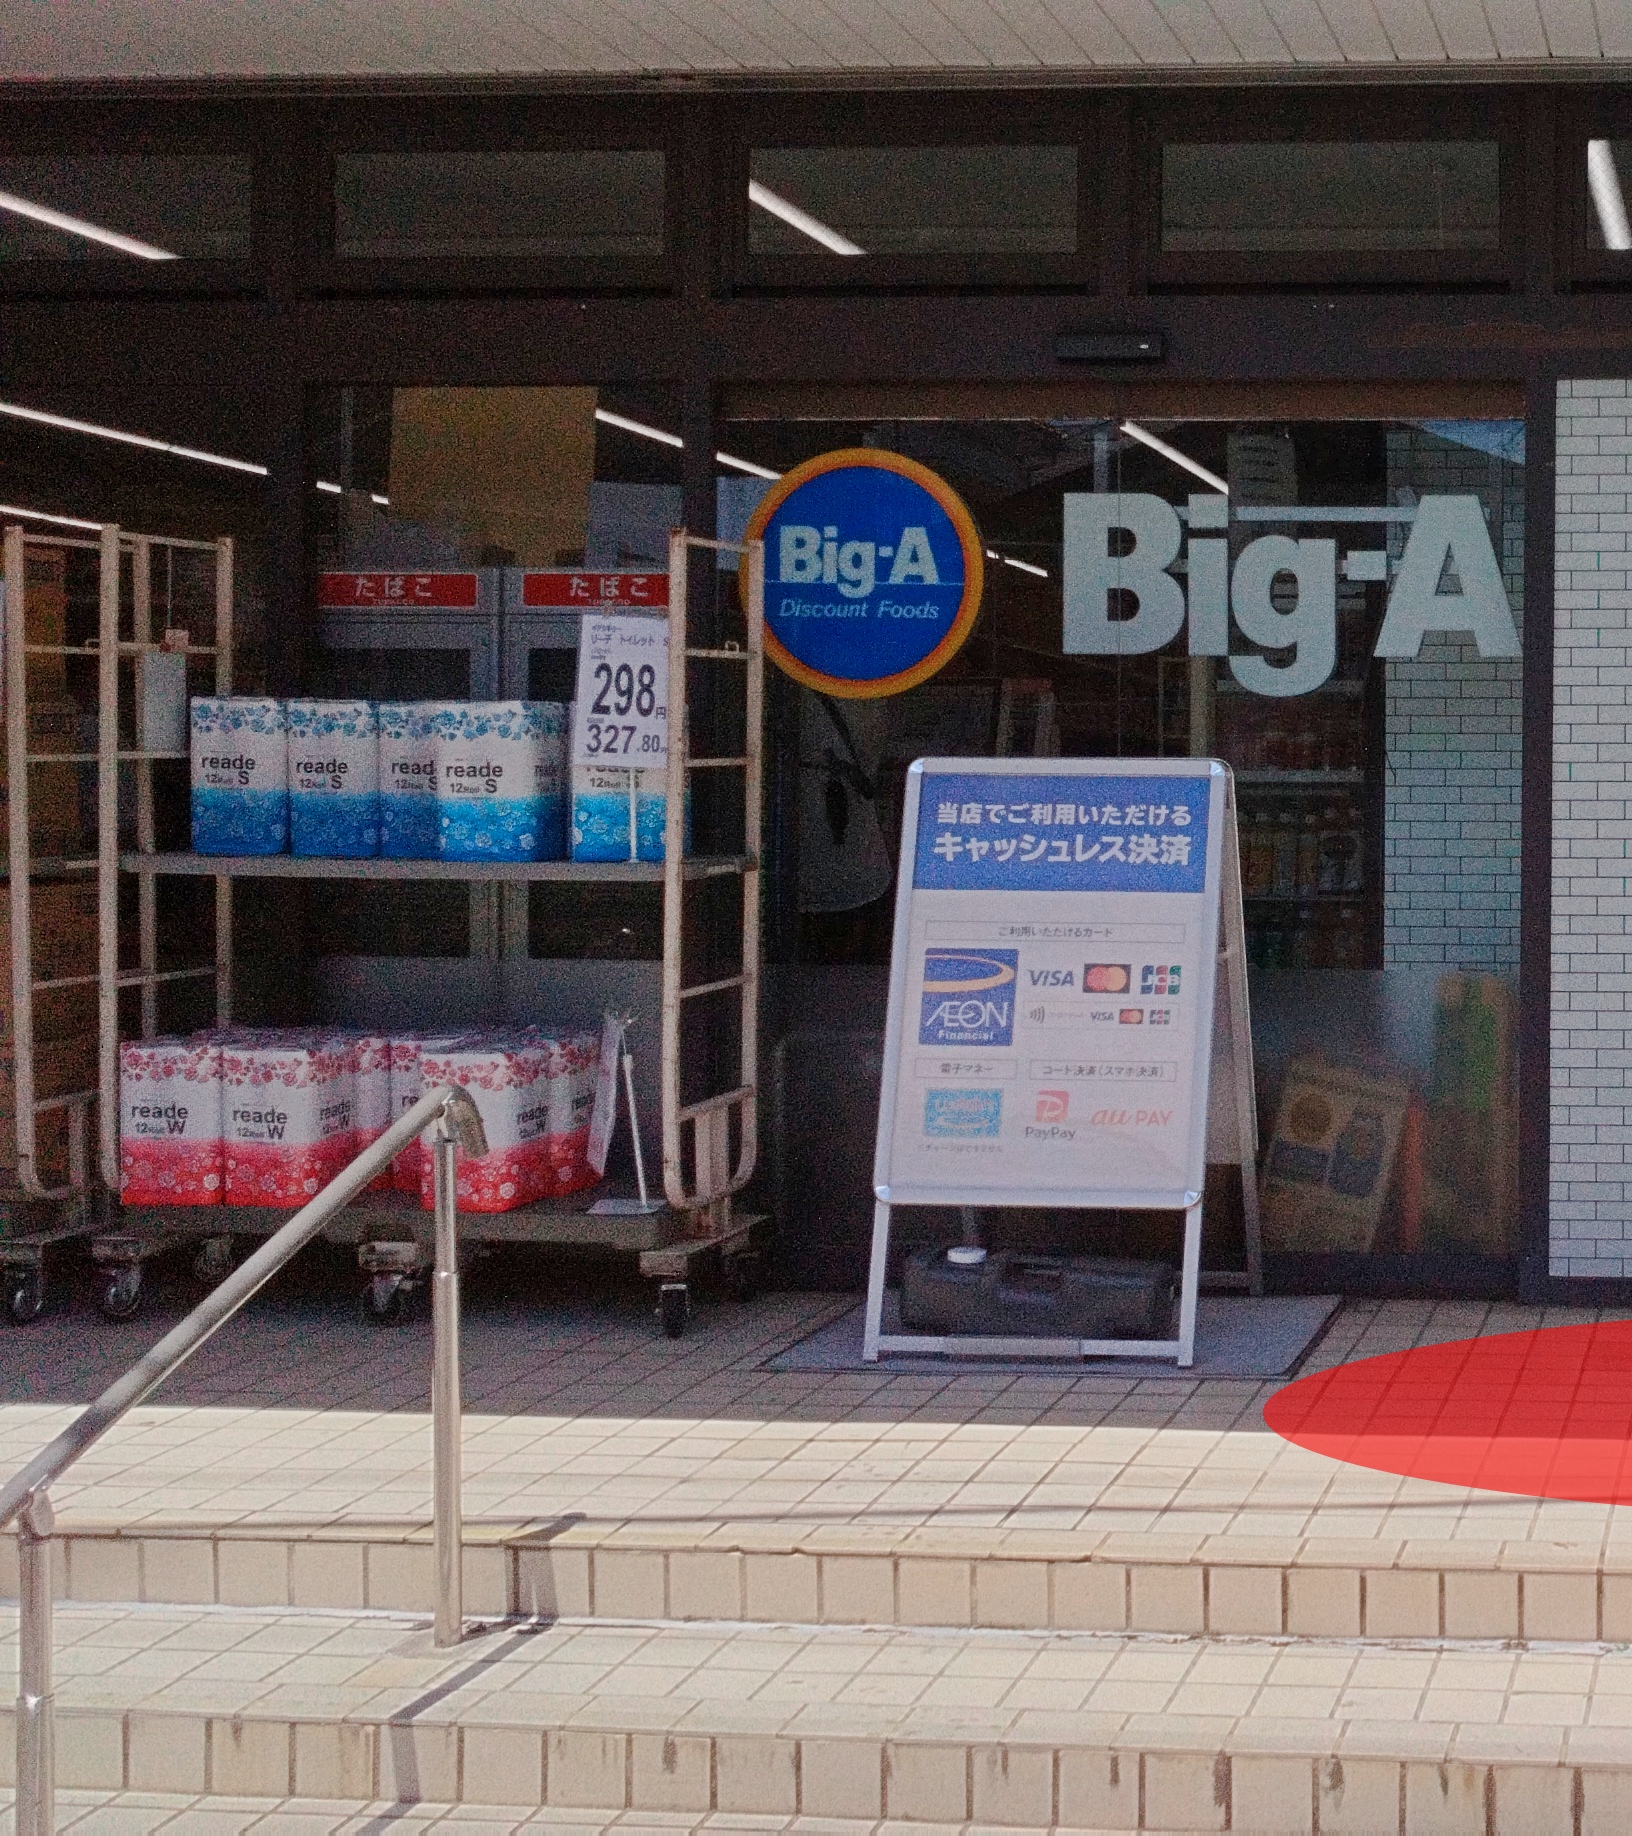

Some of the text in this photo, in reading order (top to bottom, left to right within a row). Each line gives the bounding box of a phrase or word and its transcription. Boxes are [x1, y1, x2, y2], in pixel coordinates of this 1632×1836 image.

[779, 525, 940, 599] Big-A
[355, 576, 433, 598] たばこ
[569, 576, 649, 597] たばこ
[1062, 492, 1523, 697] Big-A
[779, 598, 940, 619] Discount Foods
[201, 754, 256, 770] reade
[296, 759, 348, 774] reade
[446, 761, 504, 778] reade
[937, 802, 1192, 826] 当店でご利用いただける
[933, 832, 1192, 866] キャッシュレス決済
[1029, 970, 1075, 987] VISA
[131, 1103, 189, 1119] reade
[232, 1108, 288, 1125] reade
[1090, 1109, 1174, 1127] au PAY
[1025, 1126, 1076, 1141] PayPay
